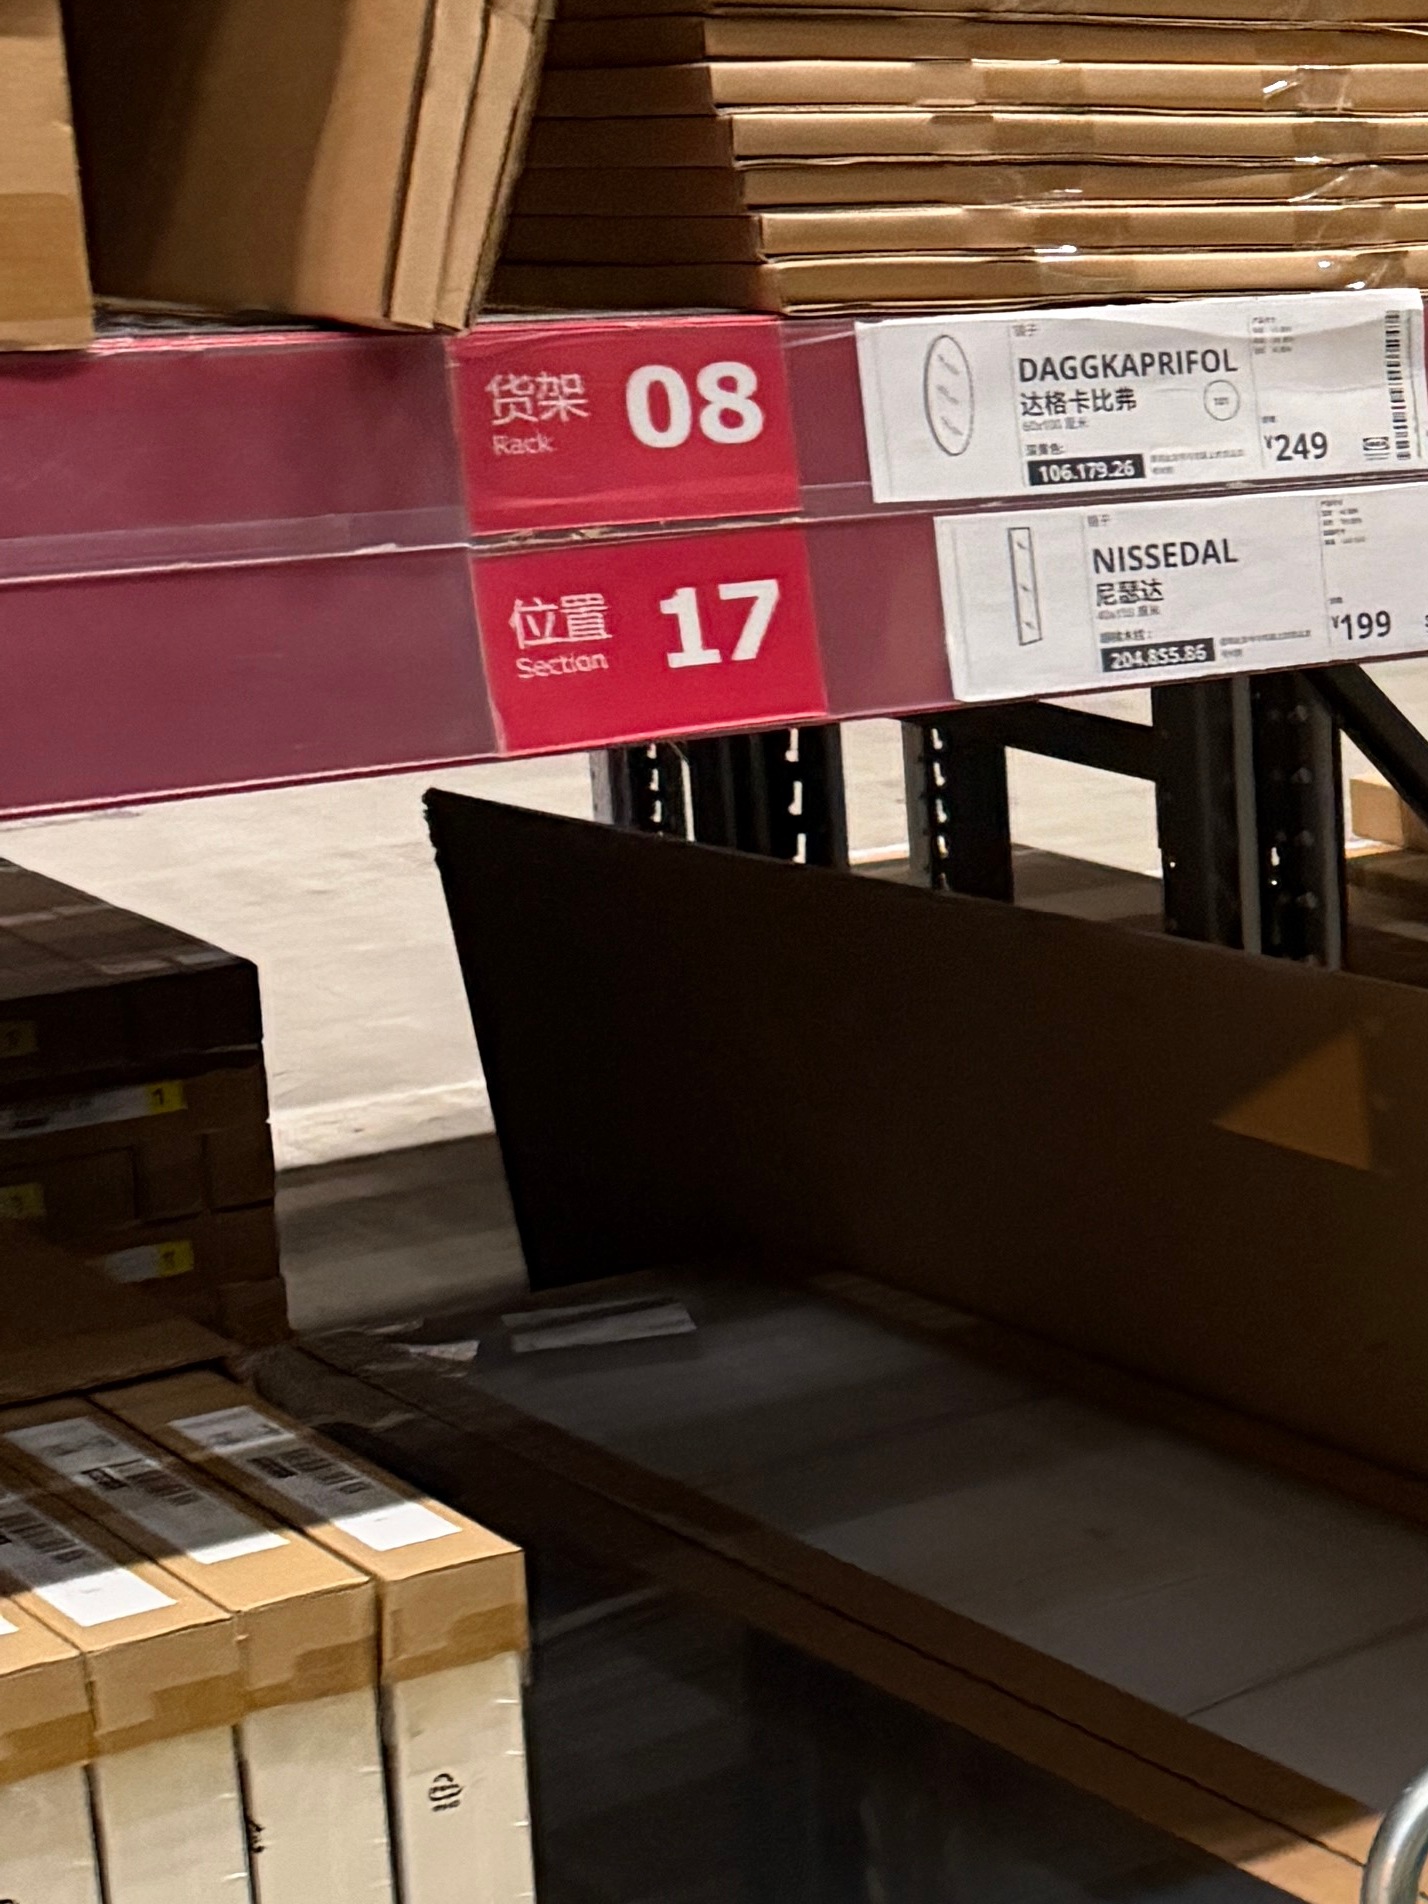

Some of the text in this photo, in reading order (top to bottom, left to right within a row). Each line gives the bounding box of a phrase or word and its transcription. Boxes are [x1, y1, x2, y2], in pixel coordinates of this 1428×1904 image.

[1018, 348, 1239, 384] DAGGKAPRIFOL
[485, 371, 590, 426] 货架
[625, 361, 764, 449] 08
[1021, 387, 1137, 417] 达格卡比弗
[493, 434, 554, 456] Rack
[1264, 431, 1329, 462] ¥249
[1038, 459, 1135, 484] 106.179.26
[1092, 538, 1239, 574] NISSEDAL
[1096, 578, 1164, 607] 尼瑟达
[508, 592, 613, 650] 位置
[659, 578, 780, 669] 17
[1331, 609, 1393, 641] ¥199
[515, 653, 609, 679] Section
